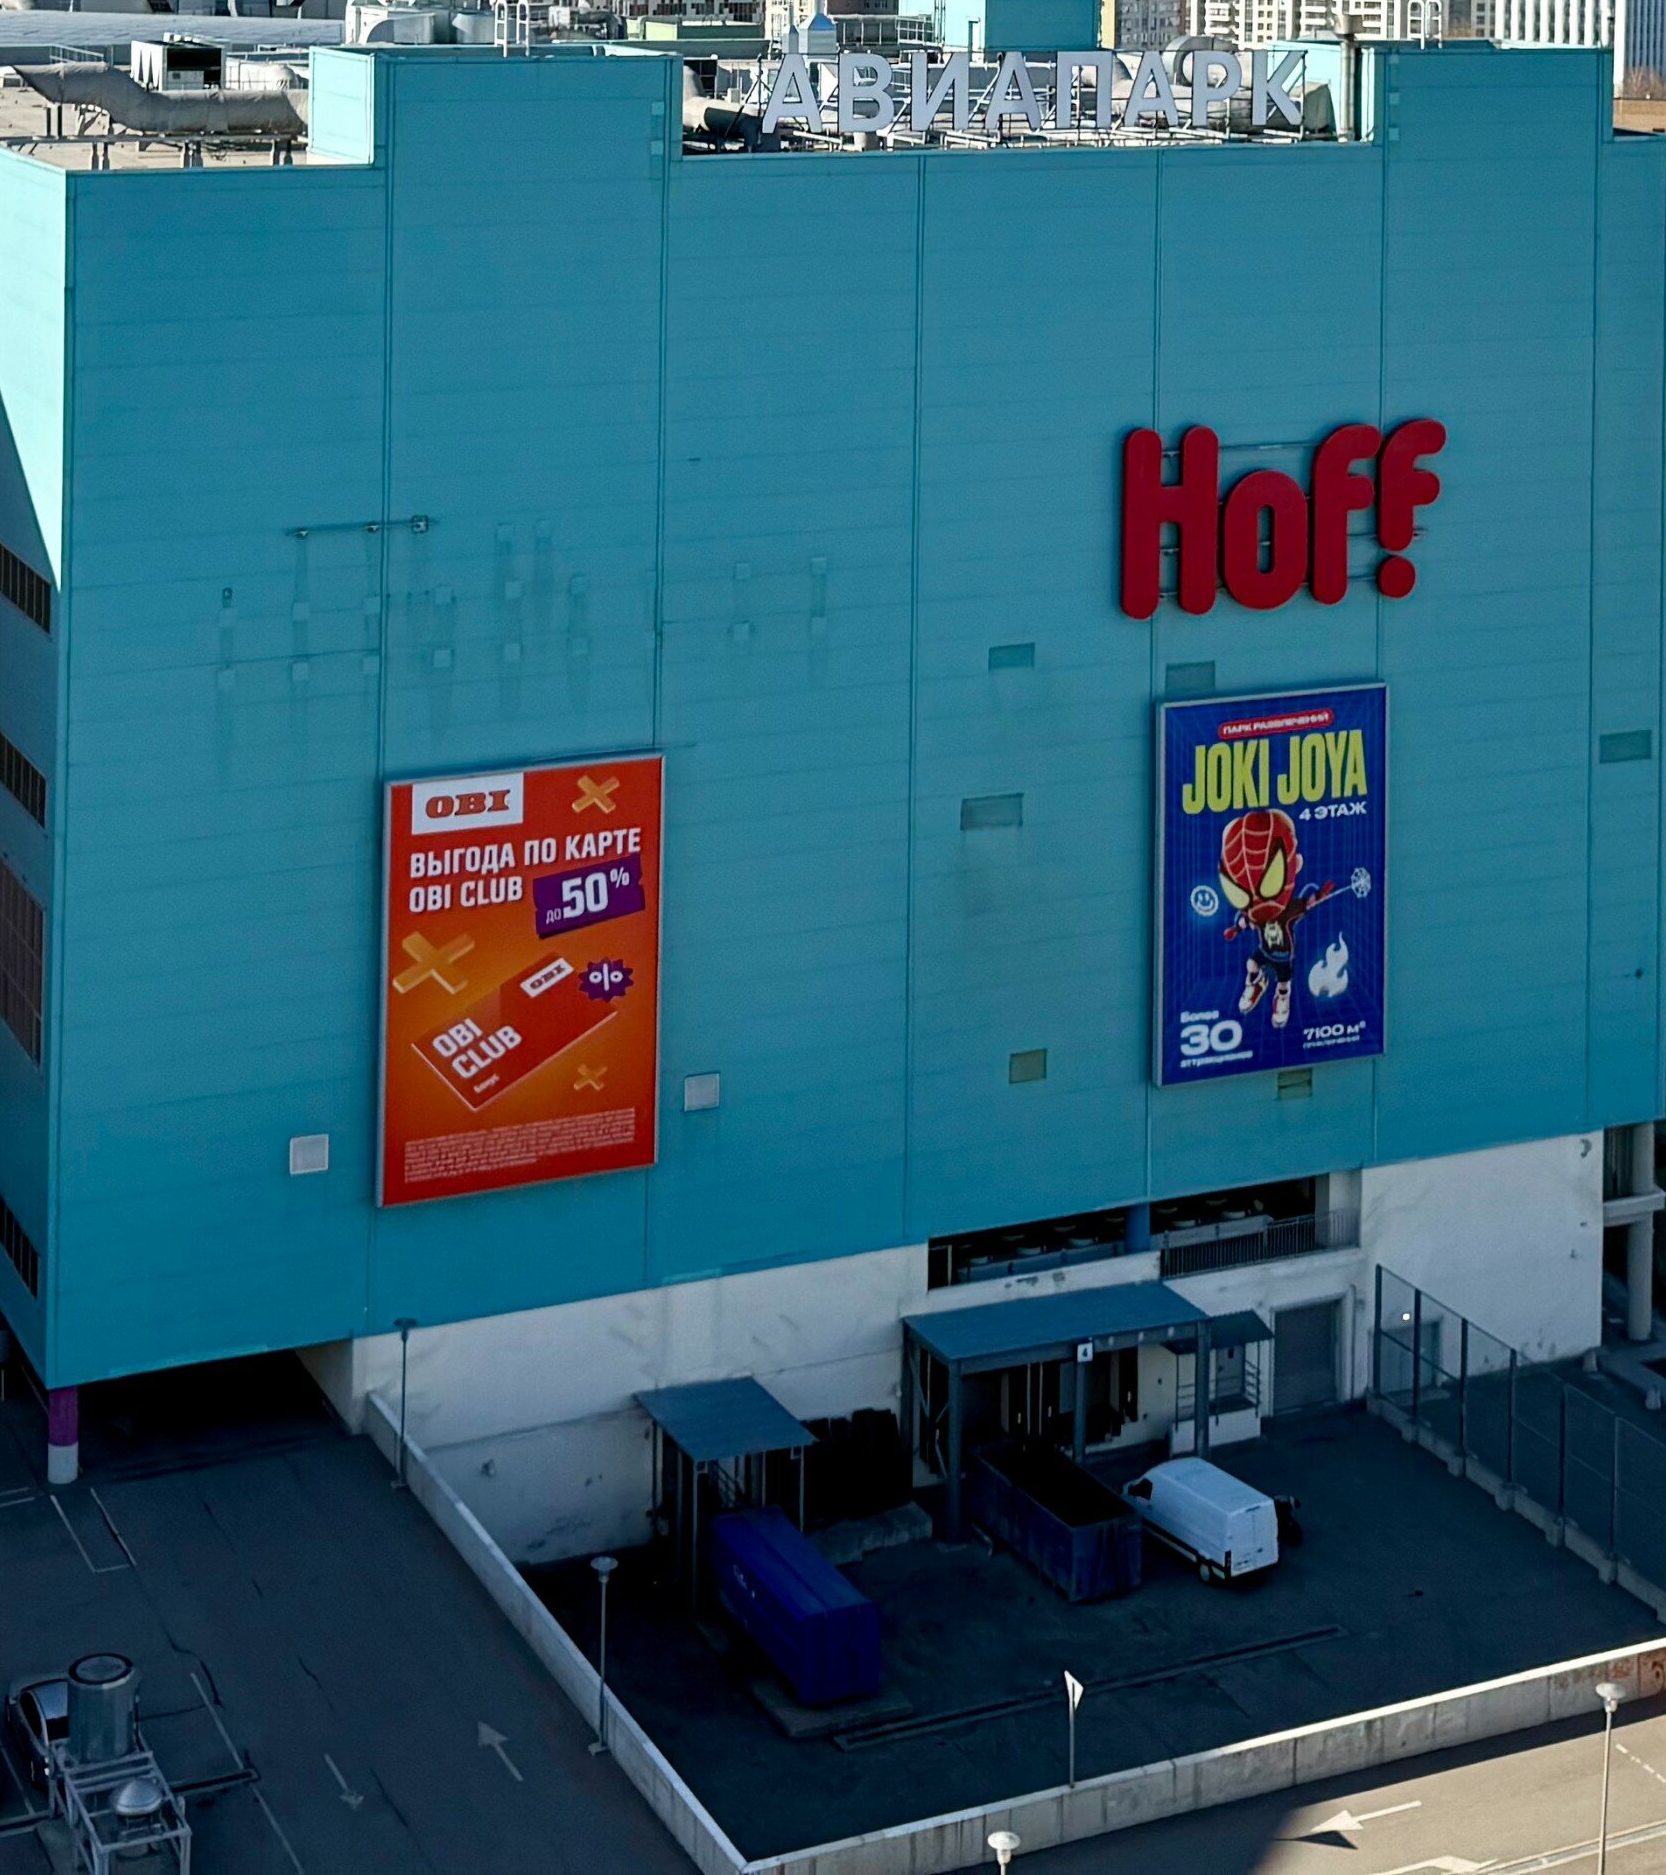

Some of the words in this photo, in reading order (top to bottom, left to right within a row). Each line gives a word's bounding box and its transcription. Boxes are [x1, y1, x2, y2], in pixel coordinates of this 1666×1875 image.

[762, 49, 1308, 134] АВИАПАРК
[1182, 738, 1270, 815] JOKI
[1277, 729, 1368, 805] JOYA
[425, 789, 511, 819] OBI
[1299, 808, 1312, 821] 4
[1314, 801, 1367, 820] ЭТАЖ
[409, 842, 516, 879] ВЫГОДА
[524, 837, 557, 866] ПО
[565, 827, 641, 861] КАРТЕ
[409, 884, 451, 913] OBI
[460, 876, 523, 908] CLUB
[432, 1017, 483, 1058] OBI
[1180, 1019, 1243, 1057] 30
[1303, 1023, 1344, 1041] 7100
[451, 1024, 523, 1080] CLUB
